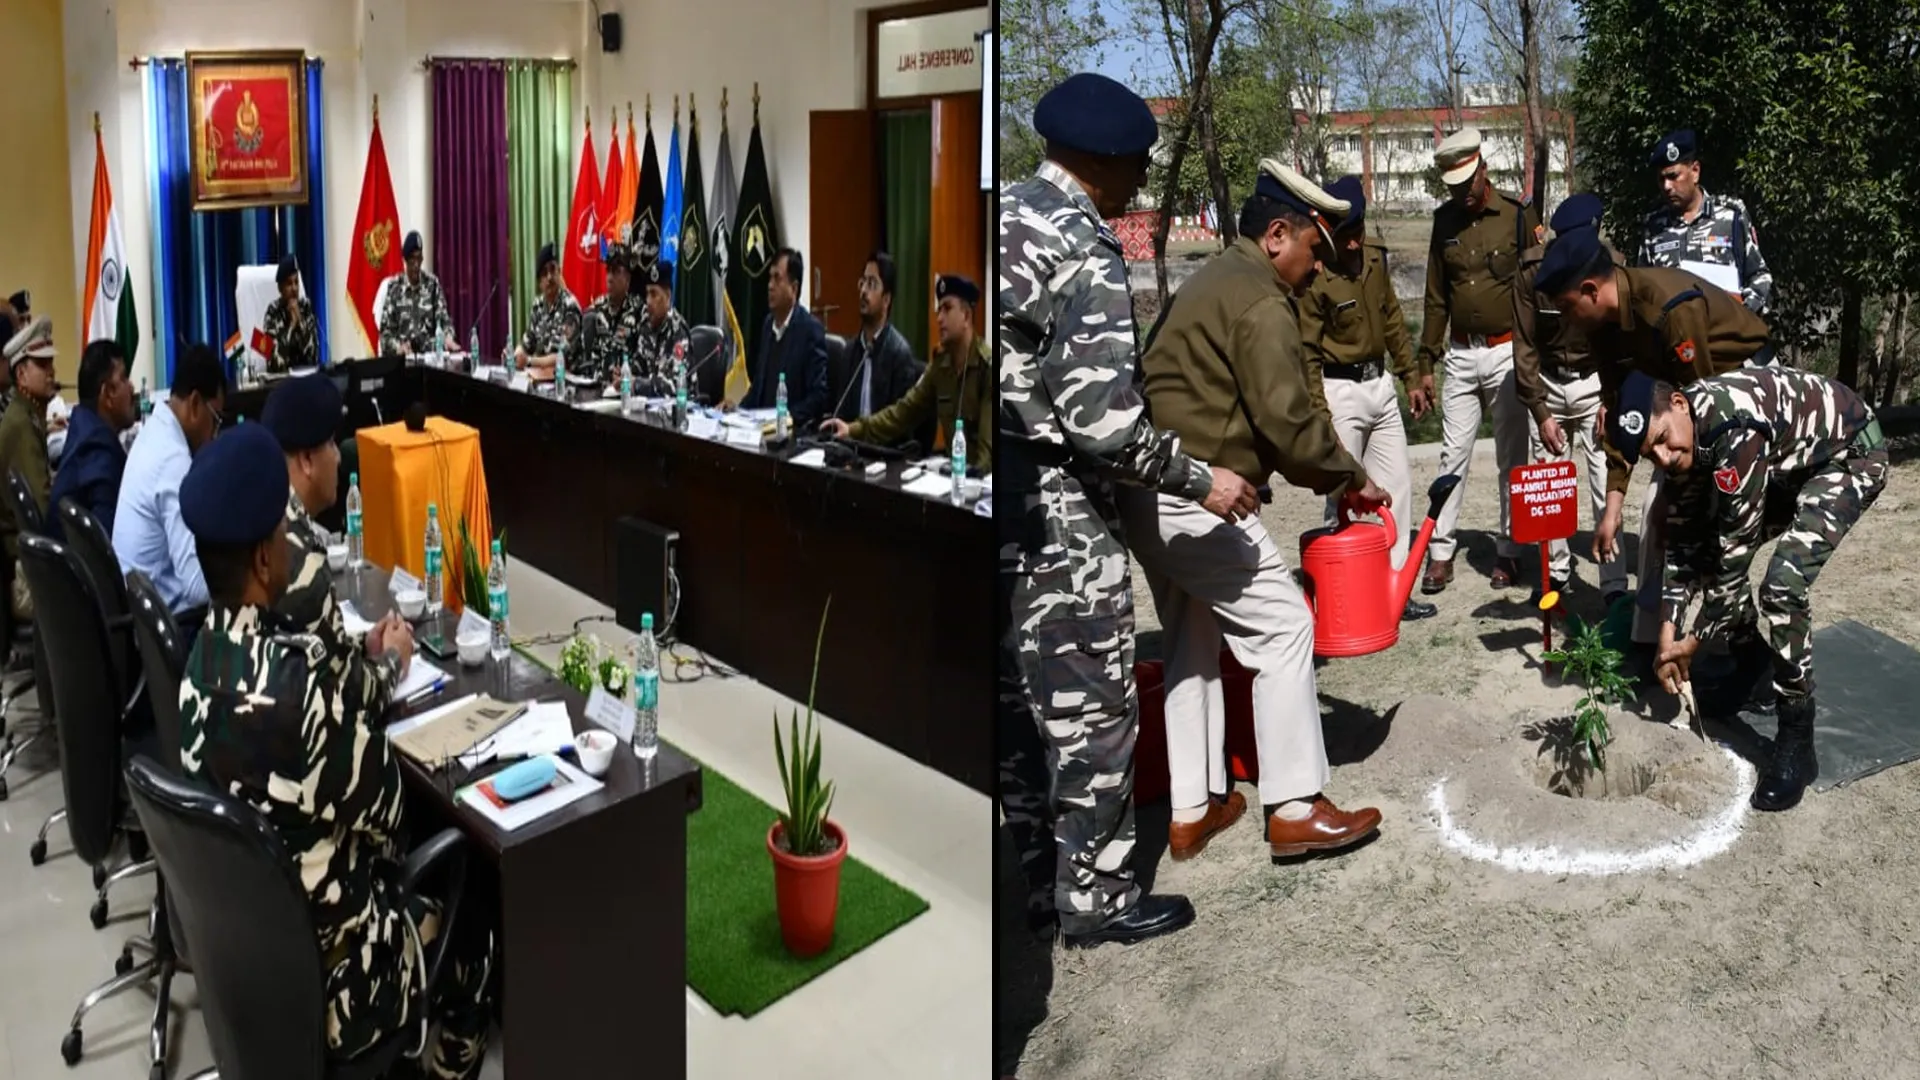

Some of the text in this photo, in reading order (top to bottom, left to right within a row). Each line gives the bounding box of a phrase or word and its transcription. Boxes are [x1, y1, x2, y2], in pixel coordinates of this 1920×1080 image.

[1521, 466, 1569, 480] PLANTED BY
[1531, 504, 1562, 517] DG SSB
